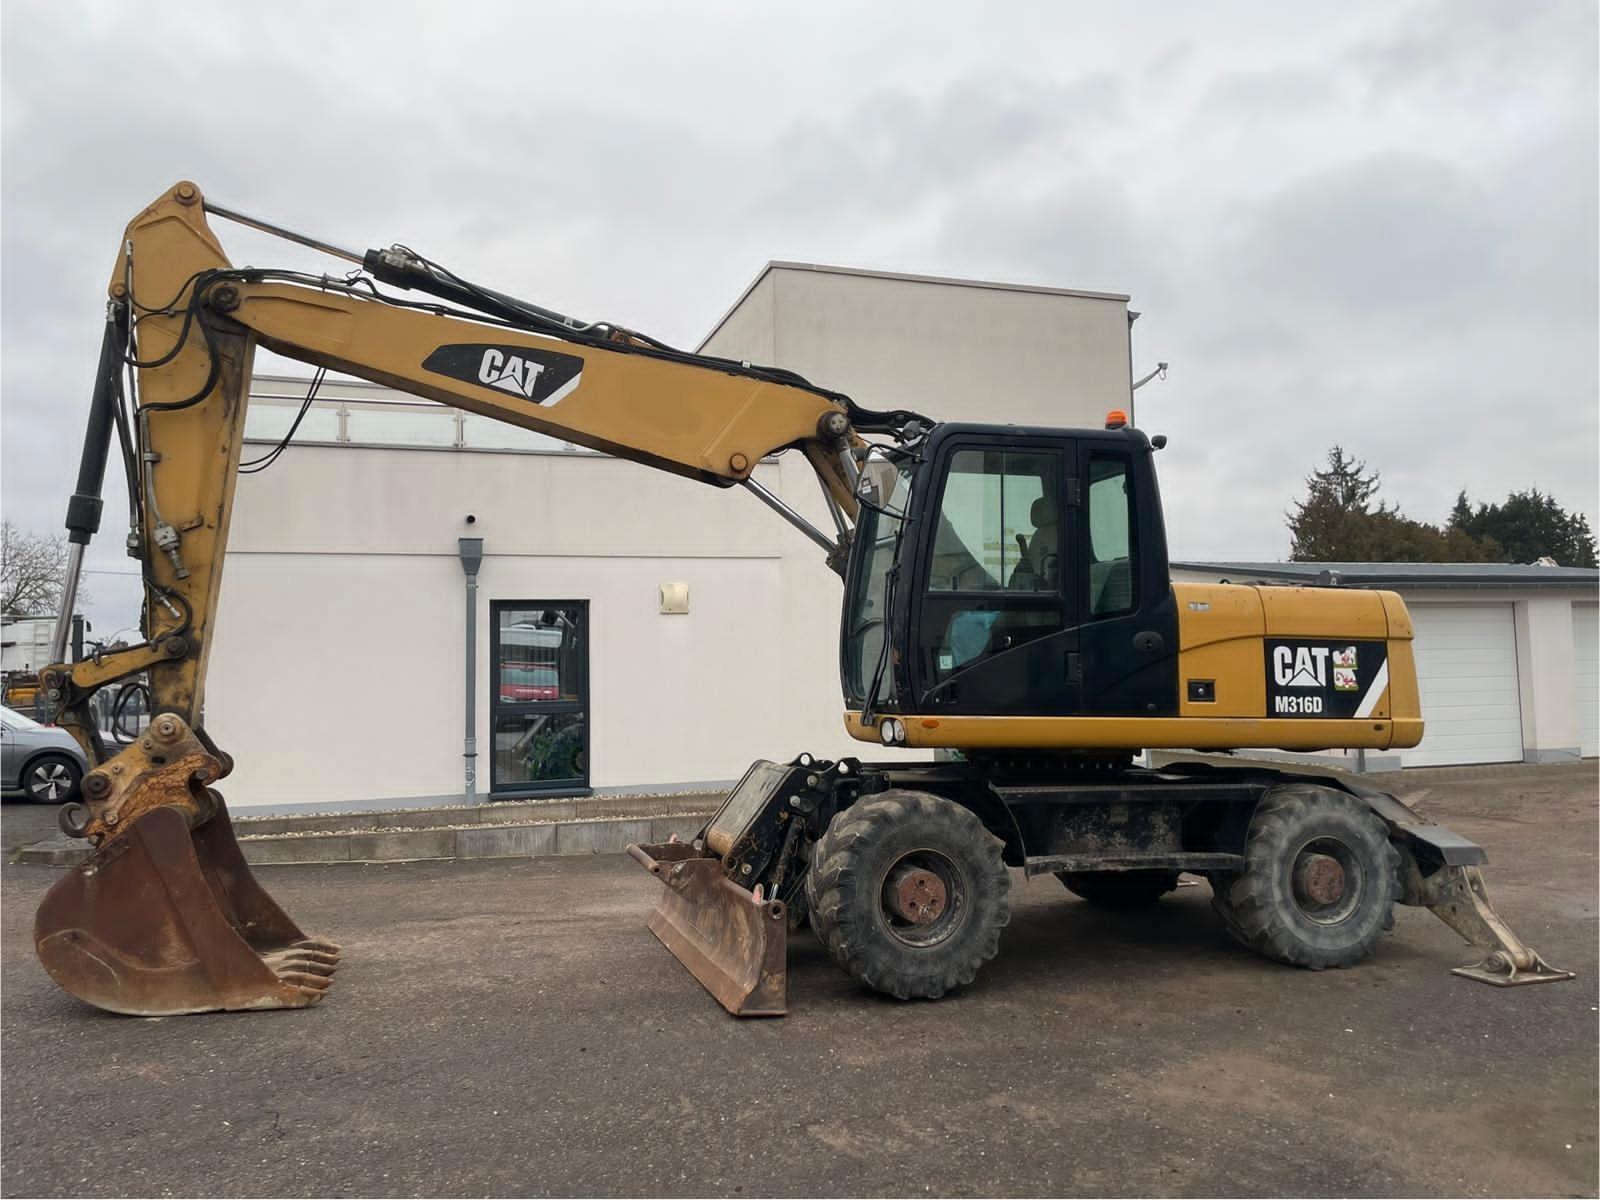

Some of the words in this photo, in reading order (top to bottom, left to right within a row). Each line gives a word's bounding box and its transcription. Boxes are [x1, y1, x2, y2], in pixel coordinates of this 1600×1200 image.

[478, 348, 545, 398] CAT
[1273, 645, 1330, 687] CAT
[1274, 695, 1323, 713] M316D
